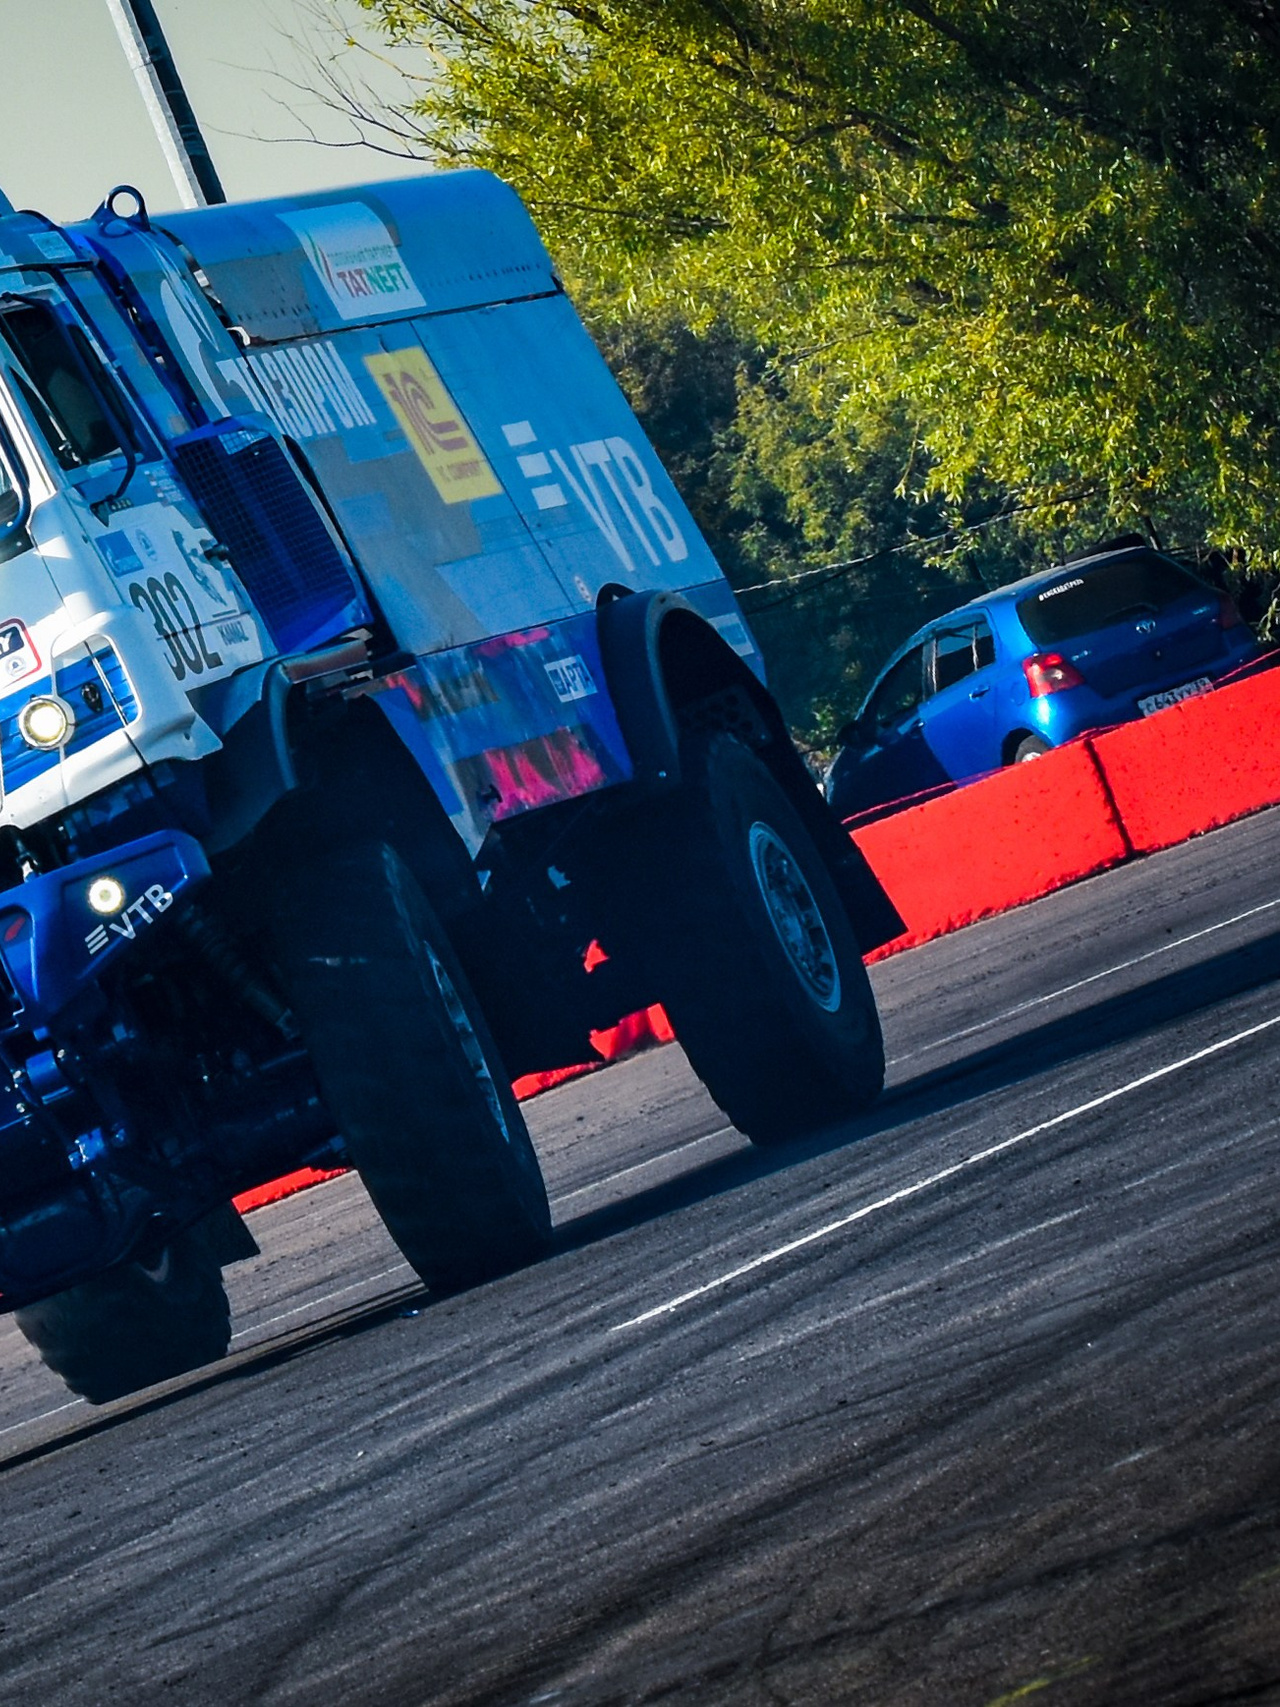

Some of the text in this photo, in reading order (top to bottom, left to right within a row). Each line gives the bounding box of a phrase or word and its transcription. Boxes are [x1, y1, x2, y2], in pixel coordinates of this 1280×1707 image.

[336, 262, 411, 298] TATNEFT
[549, 436, 688, 572] VTB
[129, 571, 223, 681] 302
[109, 884, 173, 940] VTB
